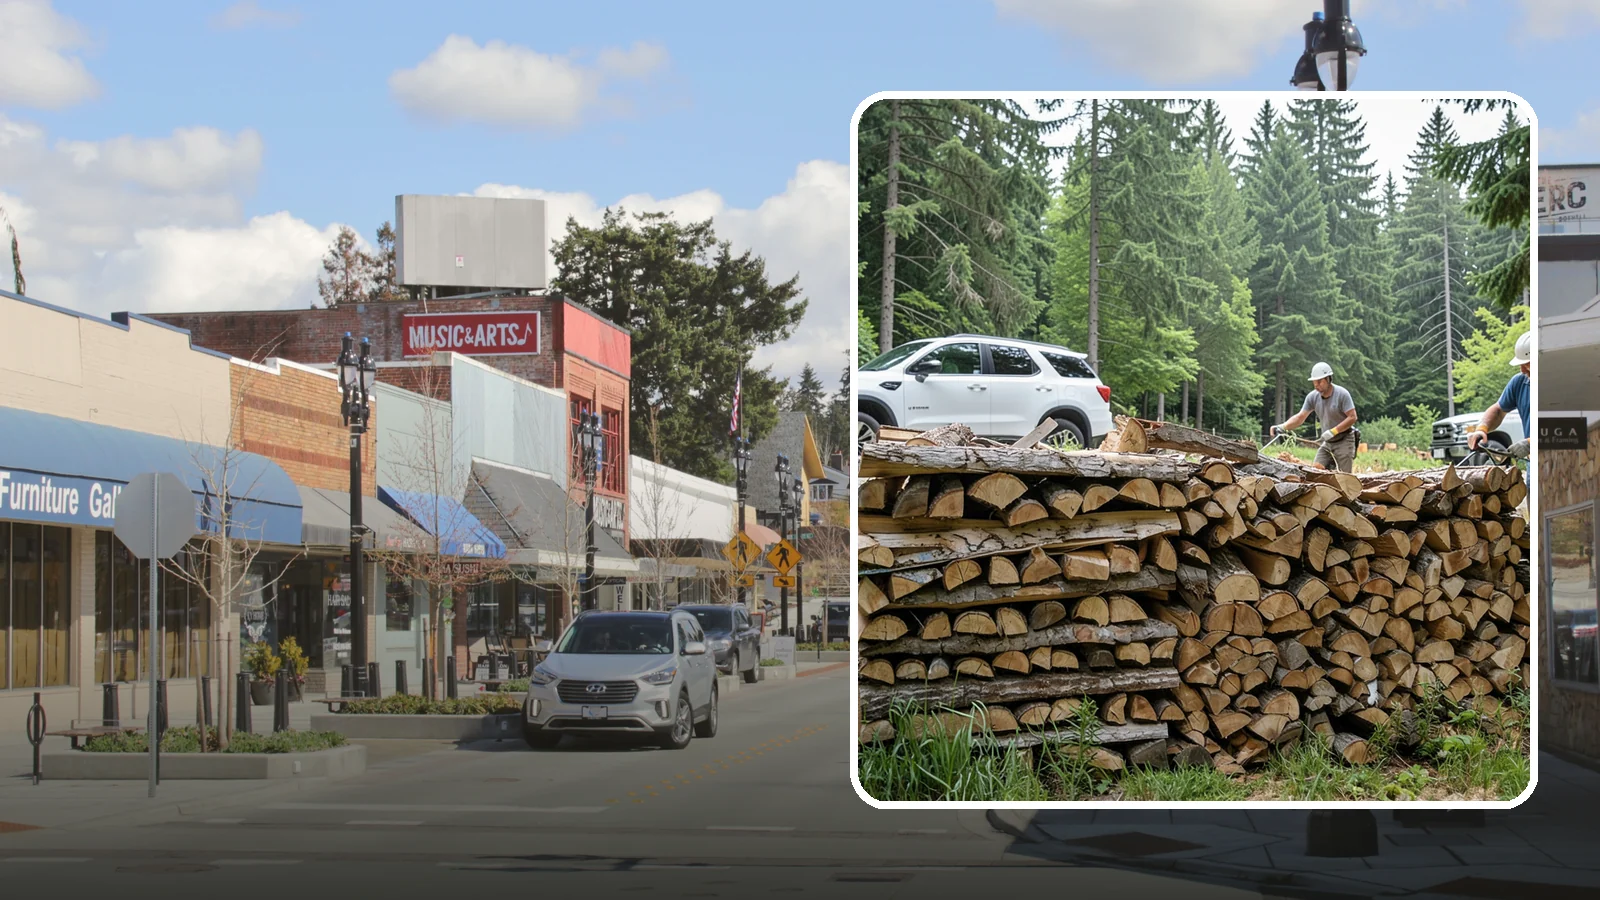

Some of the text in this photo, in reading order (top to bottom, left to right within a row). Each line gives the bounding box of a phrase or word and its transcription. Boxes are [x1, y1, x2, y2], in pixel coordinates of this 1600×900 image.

[409, 323, 519, 349] MUSIC&ARTS
[0, 471, 122, 519] Furniture Gal
